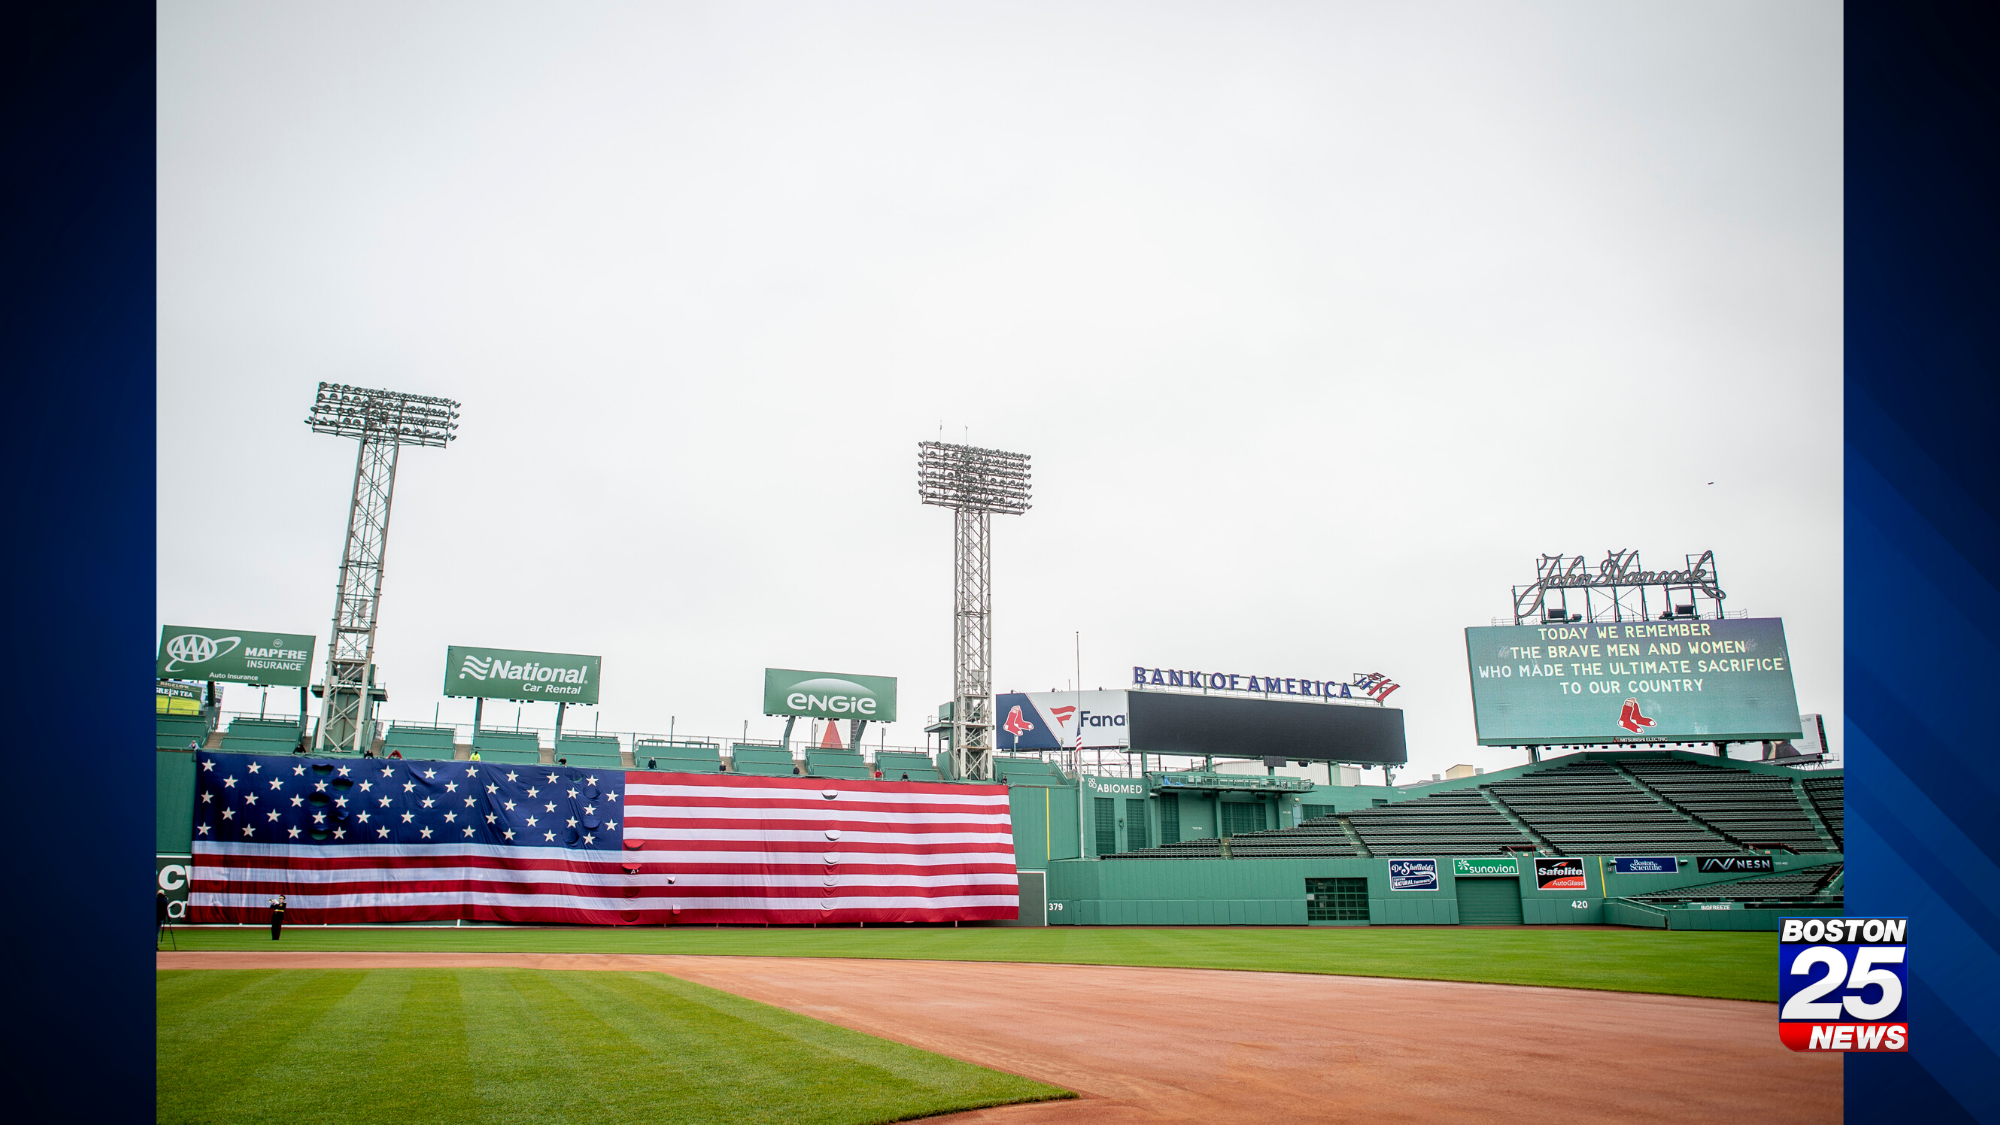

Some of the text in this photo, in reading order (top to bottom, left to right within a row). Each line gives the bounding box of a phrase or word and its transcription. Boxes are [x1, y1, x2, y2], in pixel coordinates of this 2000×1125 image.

[1515, 548, 1727, 618] John Hancock
[1538, 623, 1711, 640] TODAY WE REMEMBER
[172, 635, 212, 662] AAA
[245, 647, 307, 660] MAPFRE
[1510, 640, 1746, 659] THE BRAVE MEN AND WOMEN
[246, 660, 303, 671] INSURANCE
[1478, 657, 1785, 678] WHO MADE THE ULTIMATE SACRIFICE
[227, 673, 259, 681] Insurance
[489, 659, 587, 684] National
[1132, 666, 1352, 699] BANK OF AMERICA
[1560, 678, 1704, 695] TO OUR COUNTRY
[180, 690, 194, 698] TEA
[522, 683, 582, 695] Car Rental
[1097, 784, 1142, 794] ABIOMED
[1469, 864, 1516, 874] sunovion
[1629, 862, 1663, 871] Scientific
[1736, 859, 1771, 869] NESN
[1538, 867, 1583, 876] Safelite
[1048, 903, 1064, 911] 379
[1571, 900, 1588, 909] 420
